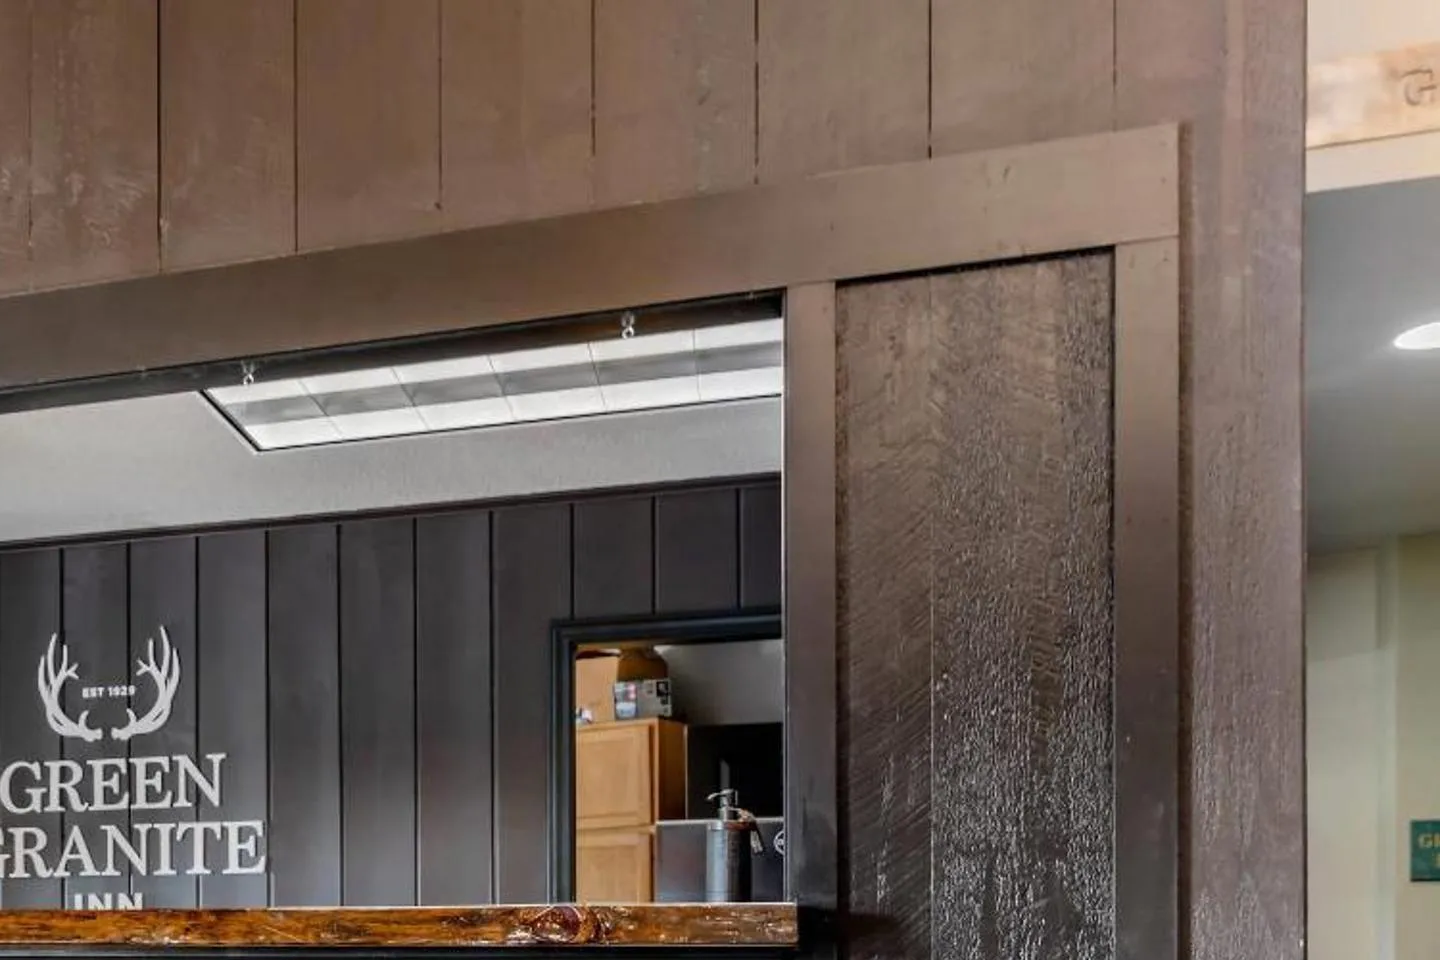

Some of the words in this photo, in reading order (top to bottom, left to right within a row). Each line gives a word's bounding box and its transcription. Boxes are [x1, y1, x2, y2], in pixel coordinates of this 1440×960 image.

[81, 686, 105, 698] EST
[0, 752, 227, 814] GREEN
[74, 892, 143, 911] INN
